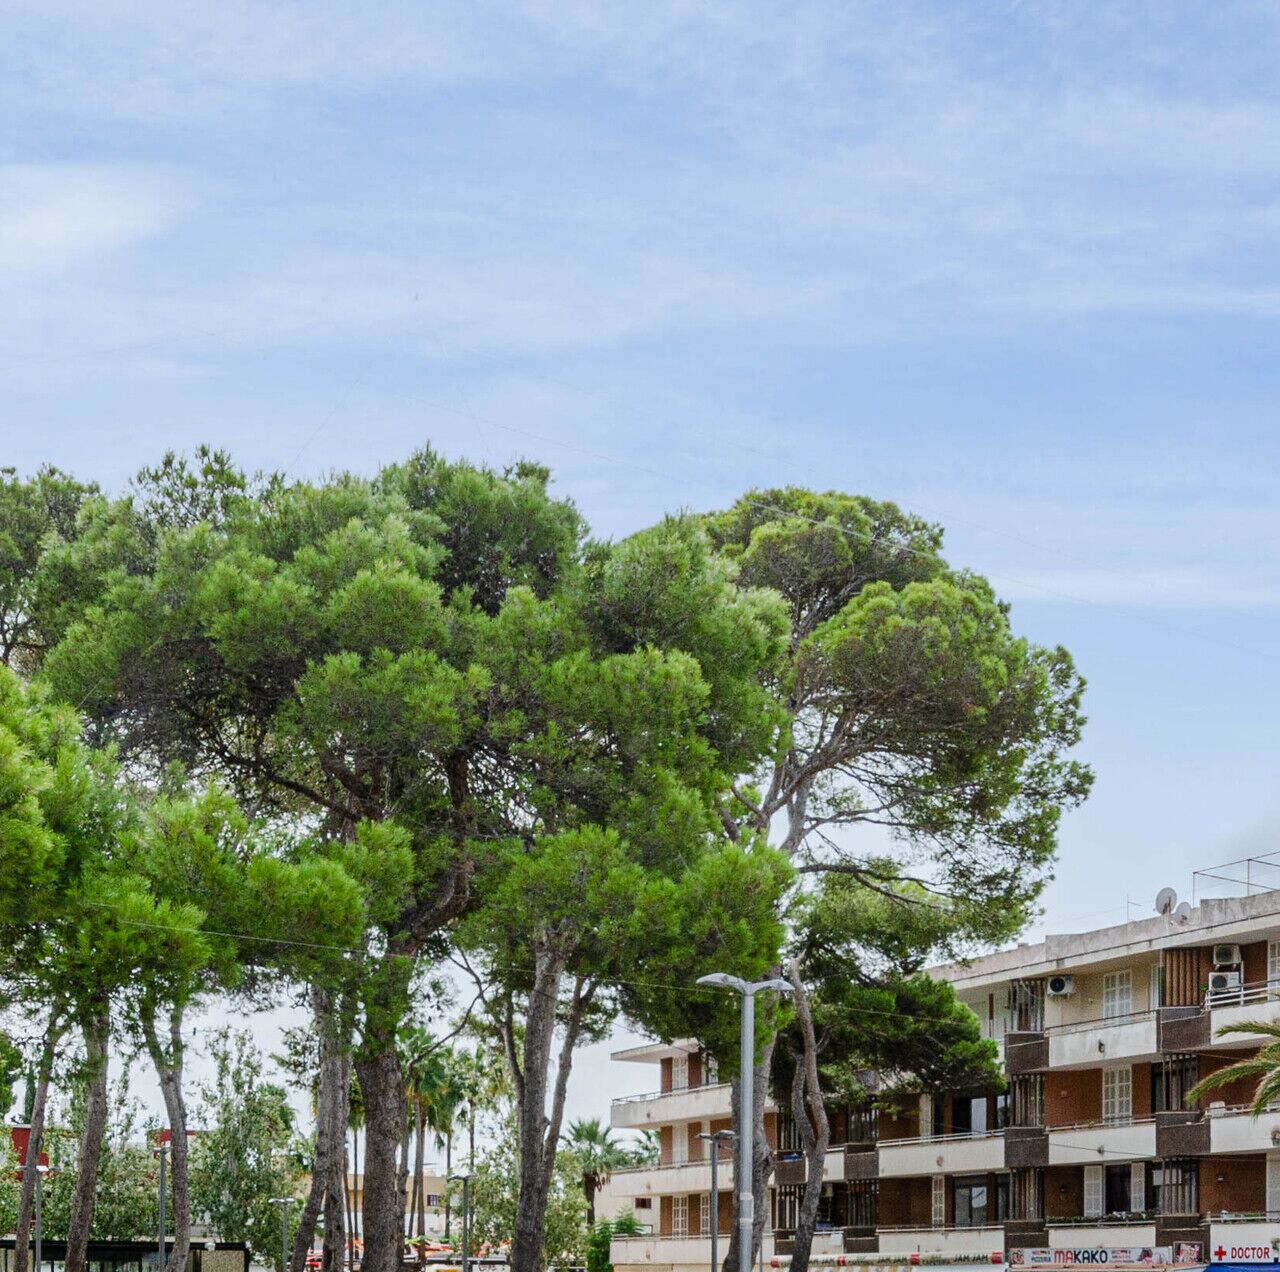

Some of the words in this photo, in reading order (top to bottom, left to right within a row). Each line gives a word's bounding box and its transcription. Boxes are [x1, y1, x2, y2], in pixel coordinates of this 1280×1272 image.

[954, 1255, 970, 1263] JAM
[972, 1254, 988, 1262] JAM
[1054, 1250, 1108, 1264] MAKAKO
[1231, 1247, 1270, 1259] DOCTOR
